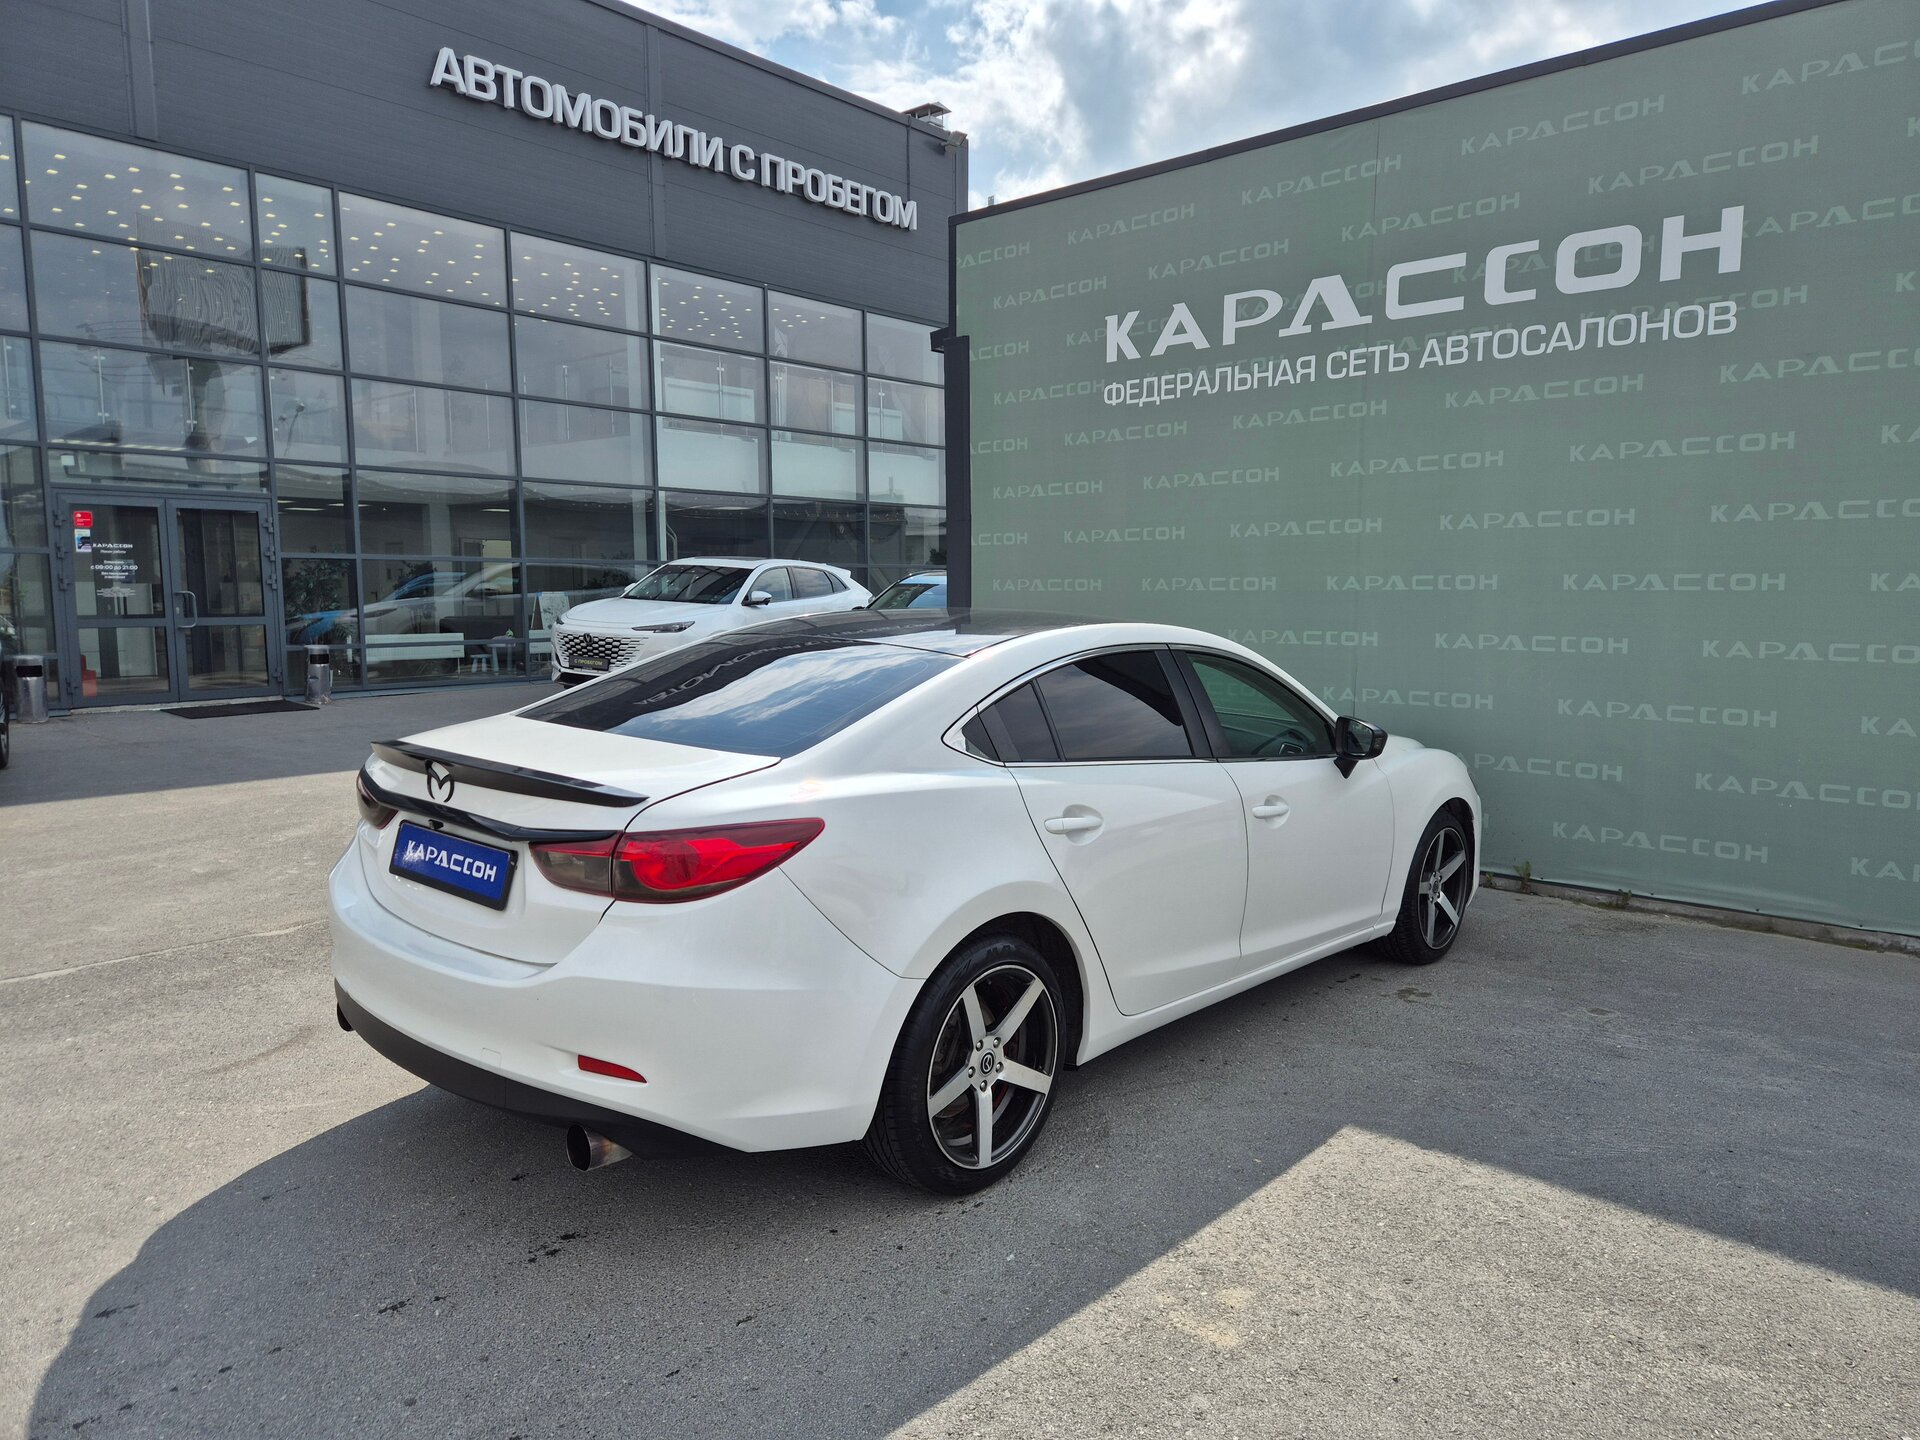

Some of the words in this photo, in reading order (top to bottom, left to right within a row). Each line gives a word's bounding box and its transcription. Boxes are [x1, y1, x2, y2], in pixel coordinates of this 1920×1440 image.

[430, 46, 724, 173] АВТОМОБИЛИ
[731, 144, 755, 182] С
[761, 153, 917, 231] ПРОБЕГОМ
[1461, 94, 1665, 155] КАРАССОН
[1242, 154, 1401, 206] КАРАССОН
[1588, 135, 1819, 195] КАРАССОН
[1067, 203, 1195, 246] КАРАССОН
[1341, 191, 1520, 242] КАРАССОН
[1148, 238, 1289, 281] КАРАССОН
[993, 276, 1107, 310] КАРАССОН
[1105, 205, 1744, 364] КАРАССОН
[1104, 354, 1316, 407] ФЕДЕРАЛЬНАЯ
[1326, 343, 1409, 380] СЕТЬ
[1418, 300, 1738, 369] АВТОСАЛОНОВ
[1720, 347, 1920, 385] КАРАСС
[993, 378, 1105, 405] КАРАССОН
[1445, 373, 1644, 409] КАРАССОН
[1233, 399, 1387, 430] КАРАССОН
[1064, 420, 1188, 447] КАРАССОН
[1570, 431, 1795, 463] КАРАССОН
[1143, 466, 1279, 490] КАРАССОН
[1330, 449, 1504, 478] КАРАССОН
[993, 480, 1103, 499] КАРАССОН
[1230, 517, 1382, 539] КАРАССОН
[1439, 508, 1636, 530] КАРАССОН
[1064, 526, 1185, 544] КАРАССОН
[993, 578, 1102, 592] КАРАССОН
[1141, 576, 1276, 592] КАРАССОН
[1326, 573, 1498, 592] КАРАССОН
[1563, 572, 1787, 592] КАРАССОН
[1228, 628, 1379, 647] КАРАССОН
[1434, 632, 1629, 656] КАРАССОН
[1322, 686, 1494, 710] КАРАССОН
[1558, 698, 1777, 729] КАРАССОН
[1695, 772, 1920, 810] КАРАССО
[1553, 821, 1769, 865] КАРАССОН
[405, 840, 498, 882] КАРАССОН
